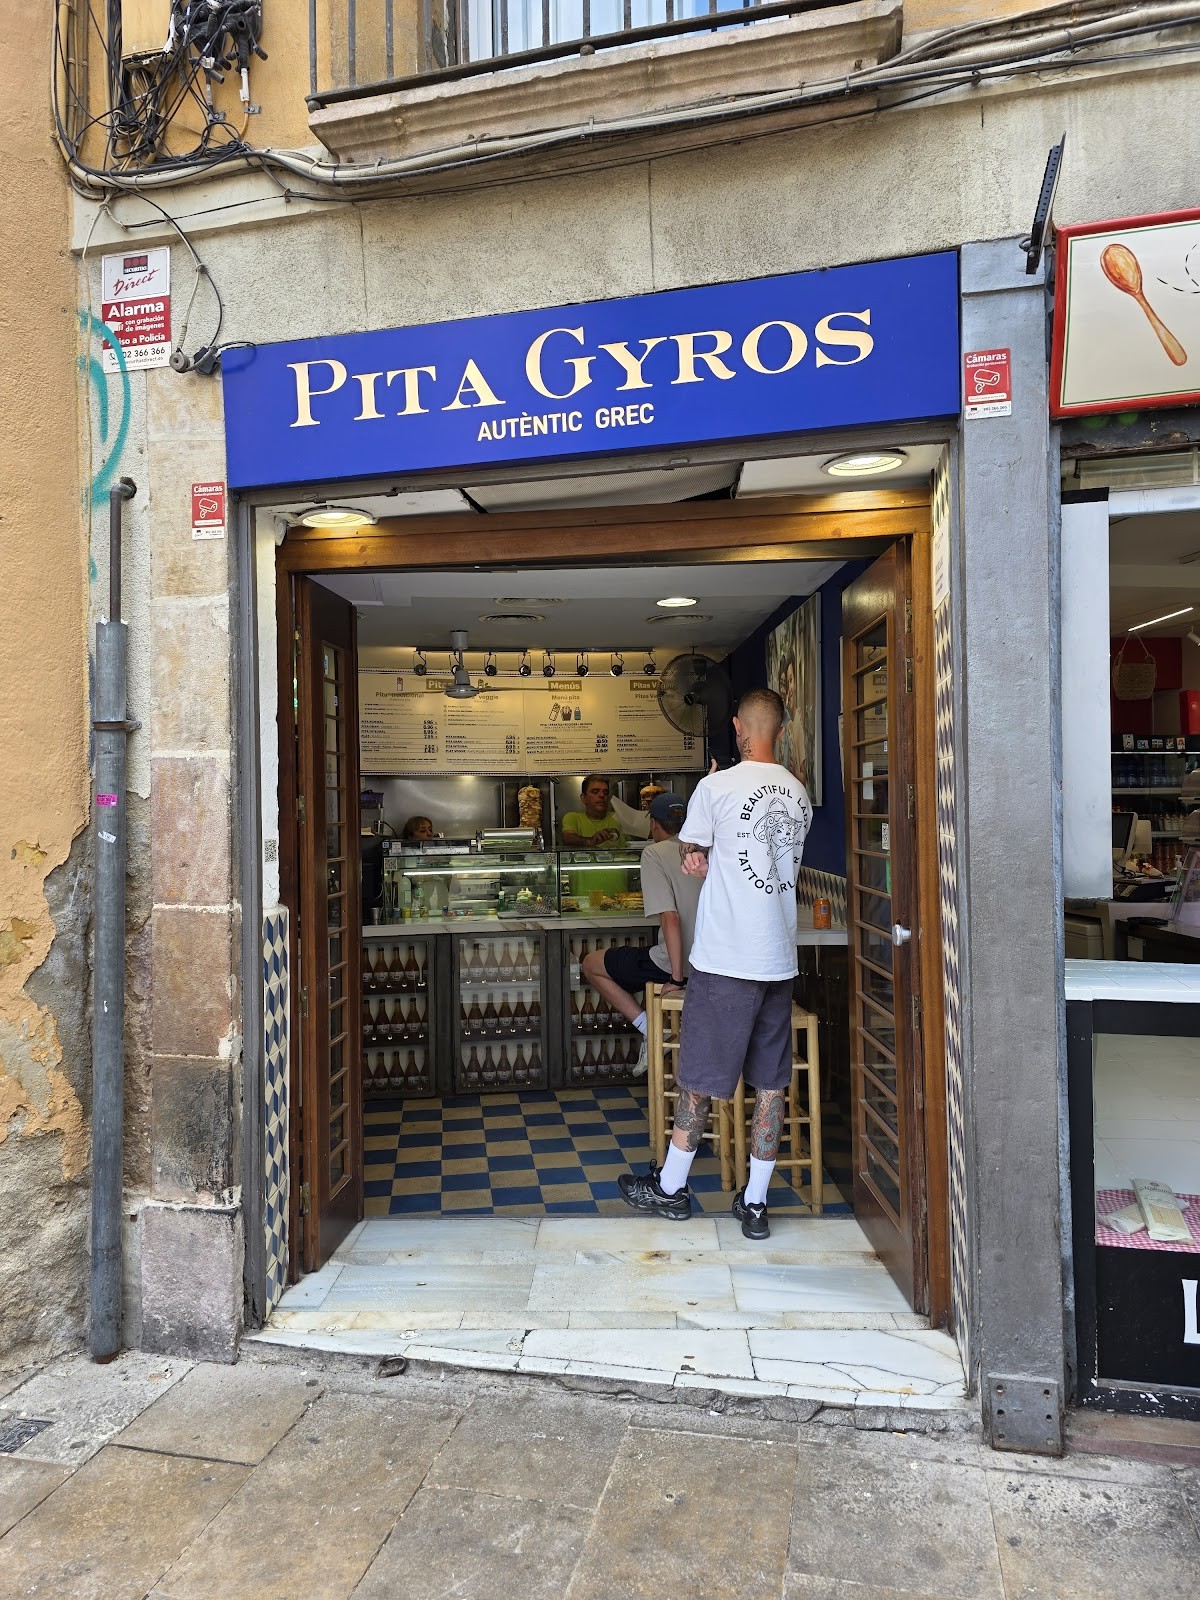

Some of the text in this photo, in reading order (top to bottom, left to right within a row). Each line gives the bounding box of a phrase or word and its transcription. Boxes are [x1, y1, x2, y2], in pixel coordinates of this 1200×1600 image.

[113, 269, 160, 296] Direct
[108, 301, 165, 319] Alarma
[136, 315, 165, 325] grabación
[135, 322, 165, 332] imágenes
[139, 333, 166, 343] Policía
[134, 349, 149, 357] 366
[151, 346, 166, 355] 366
[966, 353, 1007, 364] Cámaras
[287, 308, 875, 428] PITA GYROS
[477, 402, 655, 442] AUTÈNTIC GREC
[193, 485, 223, 493] Cámaras
[550, 681, 580, 690] Menús
[740, 785, 809, 829] BEAUTIFUL LADY
[738, 849, 774, 894] TATTOO
